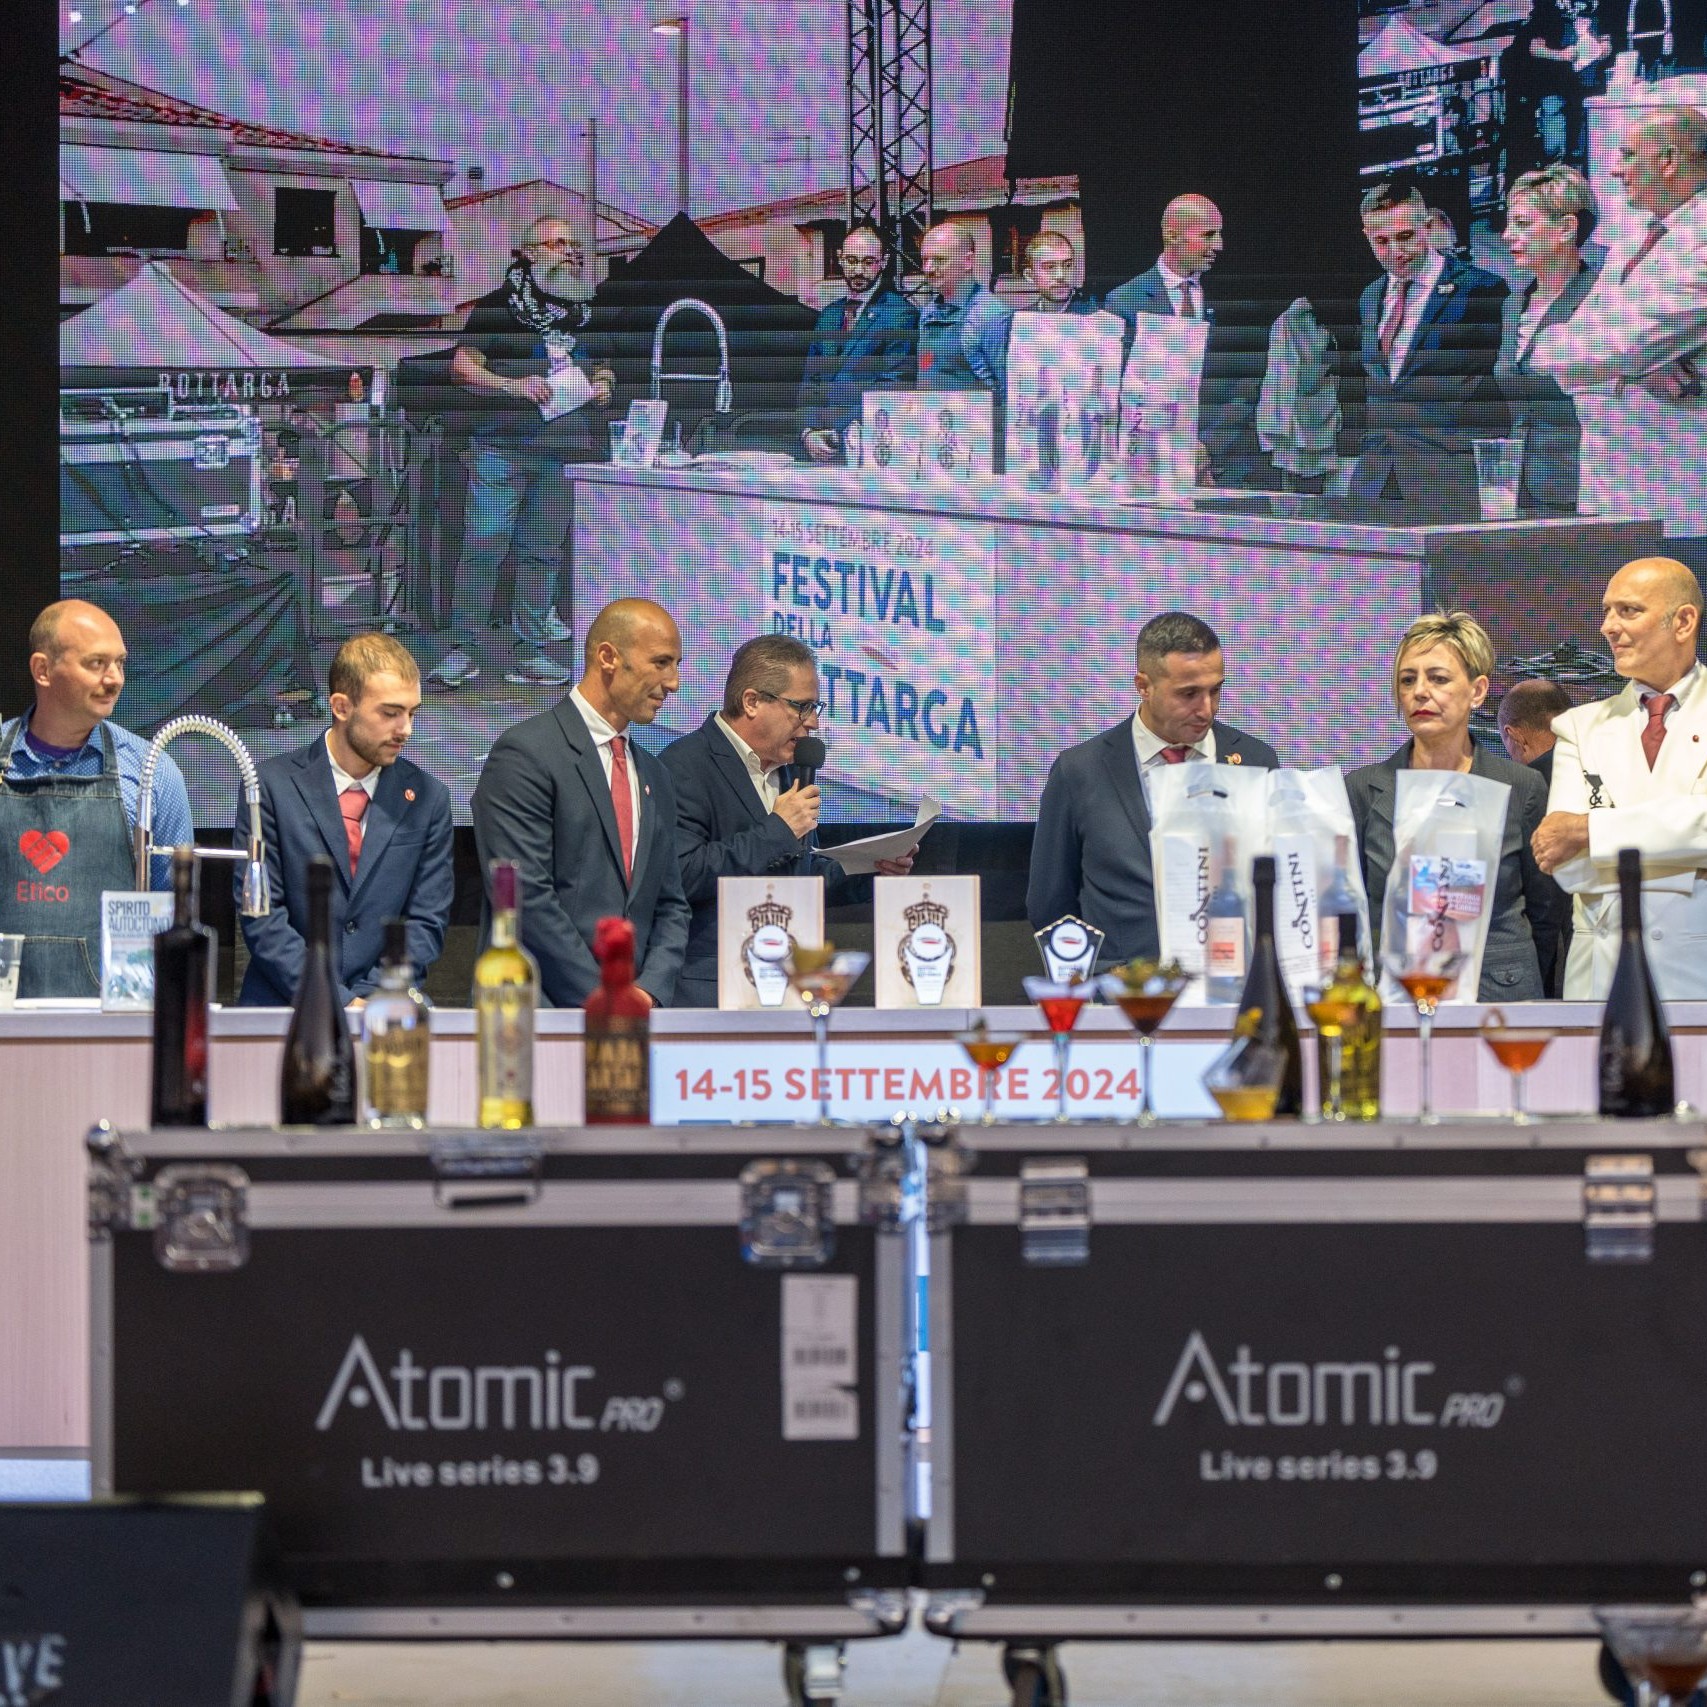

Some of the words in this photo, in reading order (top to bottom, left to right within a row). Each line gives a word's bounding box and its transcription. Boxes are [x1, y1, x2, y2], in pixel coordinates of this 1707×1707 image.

[806, 522, 891, 553] SETTEMBRE
[773, 551, 946, 633] FESTIVAL
[773, 611, 833, 650] DELLA
[822, 663, 984, 760] TTARGA
[16, 880, 70, 903] Etico
[108, 900, 150, 916] SPIRITO
[1189, 846, 1211, 945] CONTINI
[1287, 851, 1314, 950] CONTINI
[675, 1067, 773, 1101] 14-15
[784, 1066, 1030, 1102] SETTEMBRE
[1041, 1067, 1142, 1101] 2024
[314, 1332, 597, 1431] Atomic
[599, 1396, 665, 1432] PRO
[1153, 1330, 1437, 1427] Atomic
[1439, 1392, 1506, 1428] PRO
[361, 1455, 434, 1489] Live
[438, 1454, 544, 1486] series
[548, 1452, 600, 1485] 3.9
[1200, 1449, 1273, 1481] Live
[1276, 1449, 1382, 1481] series
[1385, 1448, 1438, 1480] 3.9
